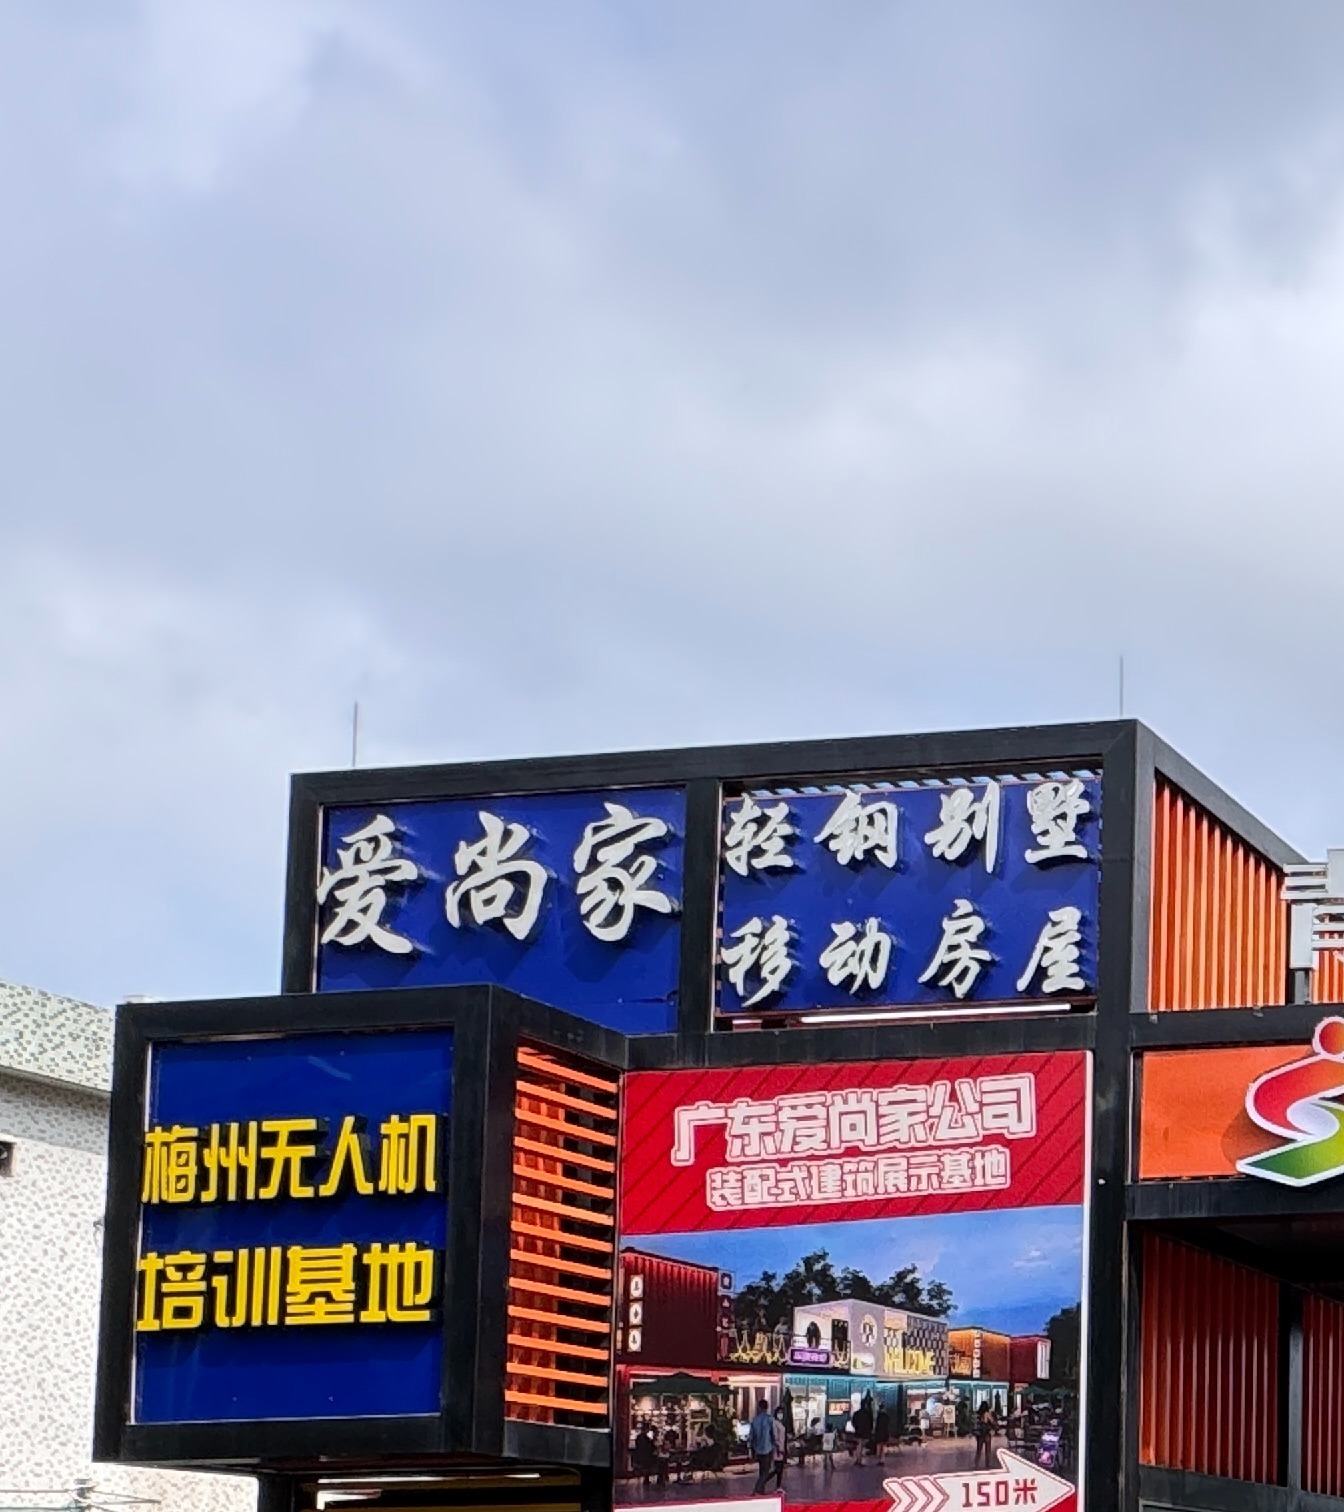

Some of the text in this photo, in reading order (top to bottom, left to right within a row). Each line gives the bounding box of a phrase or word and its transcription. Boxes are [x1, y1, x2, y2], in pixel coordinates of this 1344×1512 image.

[723, 777, 1091, 877] 轻钢别墅
[316, 802, 678, 954] 爱尚家
[719, 897, 1087, 1009] 移动房屋
[141, 1113, 438, 1204] 梅州无人机
[671, 1072, 1037, 1167] 广东爱尚家公司
[705, 1147, 1010, 1212] 装配式建筑展示基地
[135, 1241, 435, 1333] 培训基地
[961, 1477, 1038, 1508] 150米
